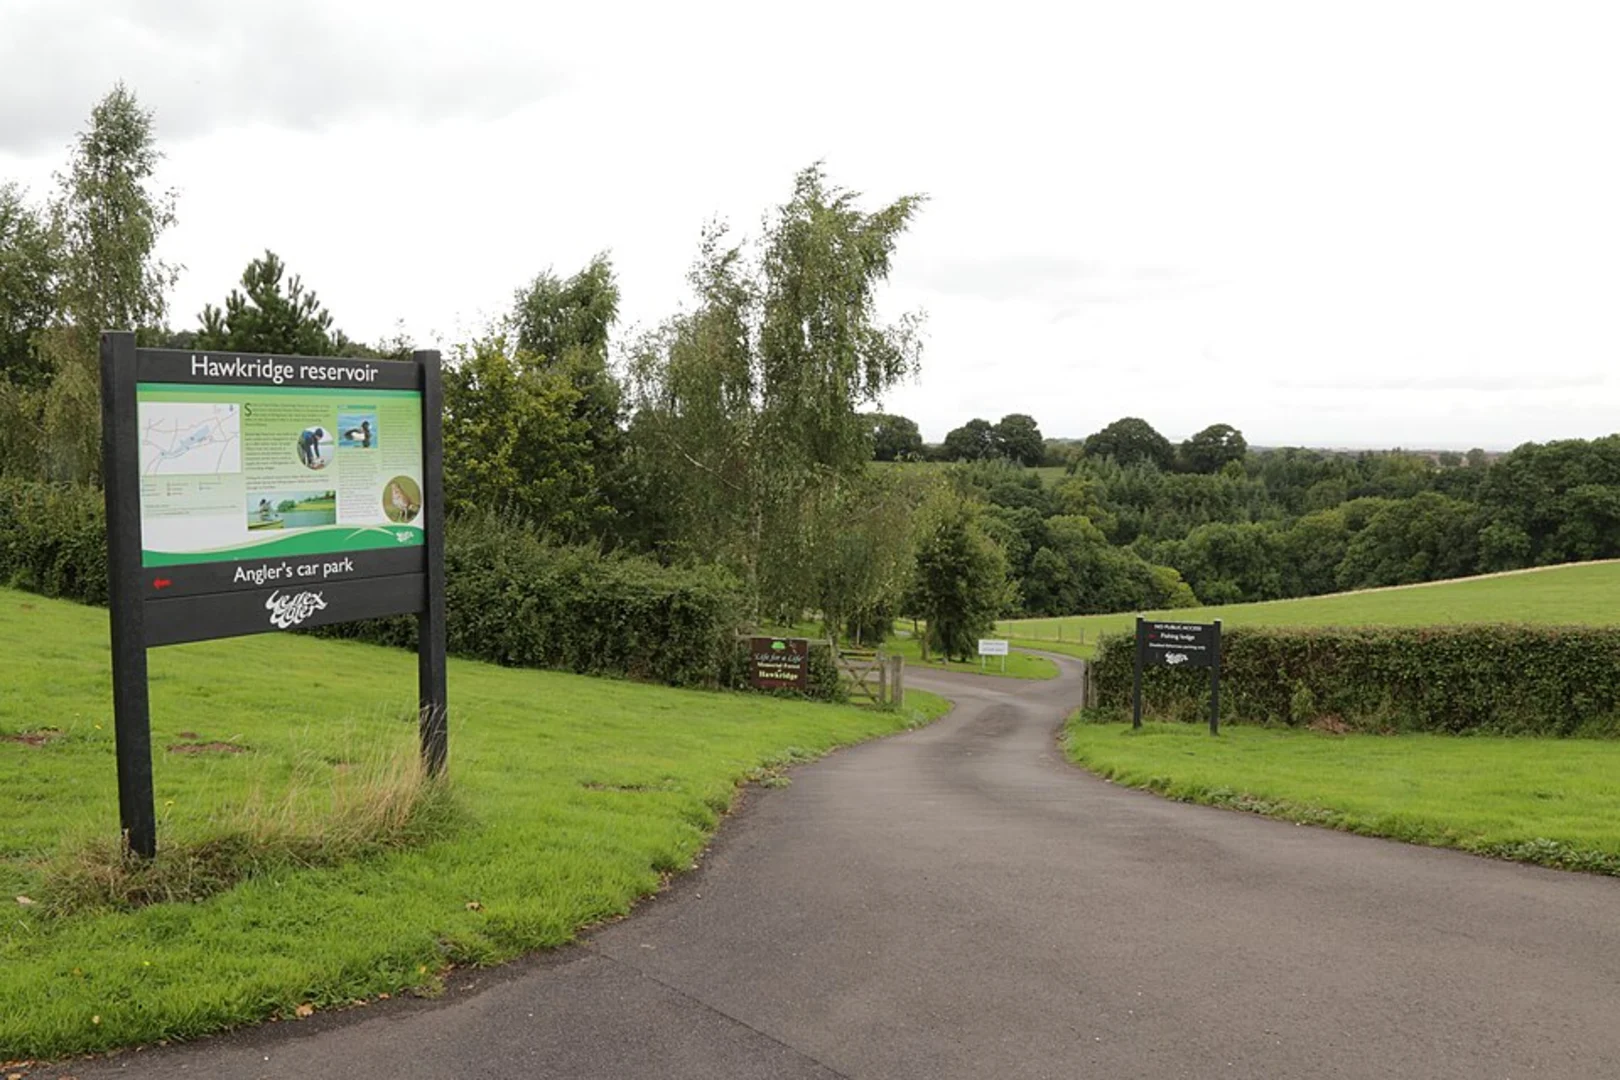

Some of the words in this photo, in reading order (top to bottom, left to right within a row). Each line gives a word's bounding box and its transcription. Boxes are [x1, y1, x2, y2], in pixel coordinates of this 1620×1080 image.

[191, 354, 294, 384] Hawkridge
[300, 364, 379, 382] reservoir
[233, 561, 293, 585] Angler's
[297, 563, 319, 576] car
[323, 556, 354, 578] park
[1160, 632, 1178, 640] Fishing
[758, 670, 798, 680] Hawkridge
